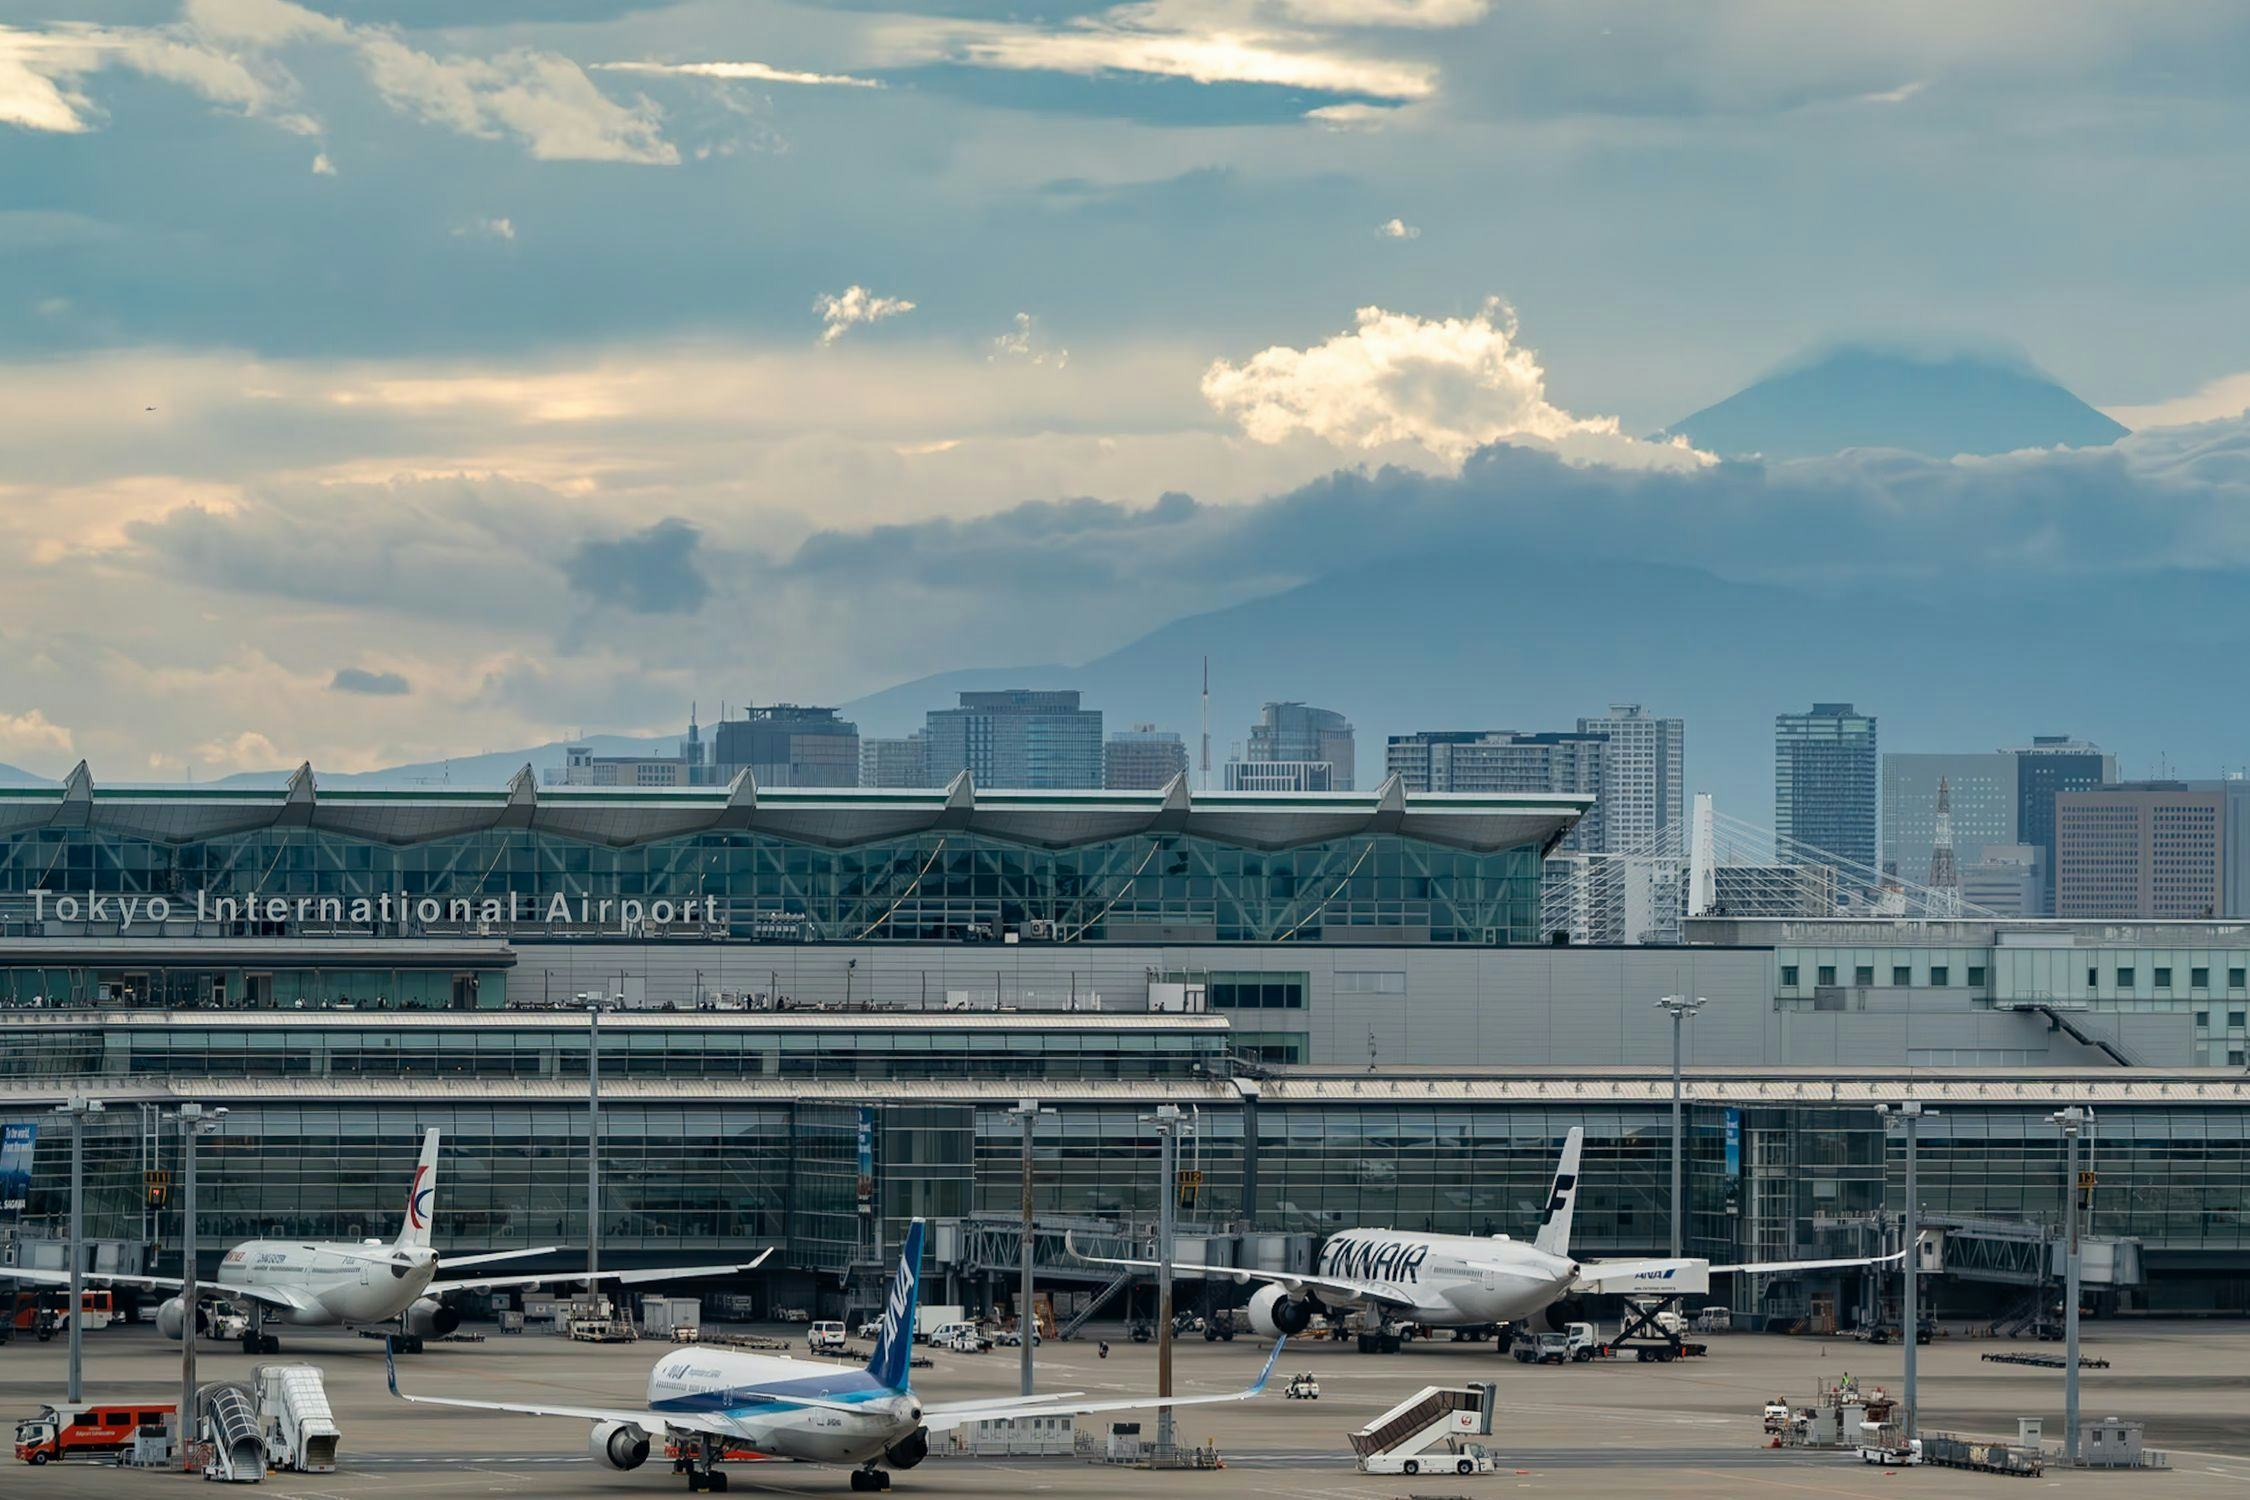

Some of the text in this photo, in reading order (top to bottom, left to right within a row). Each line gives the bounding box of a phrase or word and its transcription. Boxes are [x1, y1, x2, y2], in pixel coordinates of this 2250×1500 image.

[27, 889, 718, 931] Tokyo International Airport
[1316, 1238, 1429, 1284] FINNAIR
[1634, 1271, 1662, 1279] ANA
[884, 1254, 914, 1363] ANA
